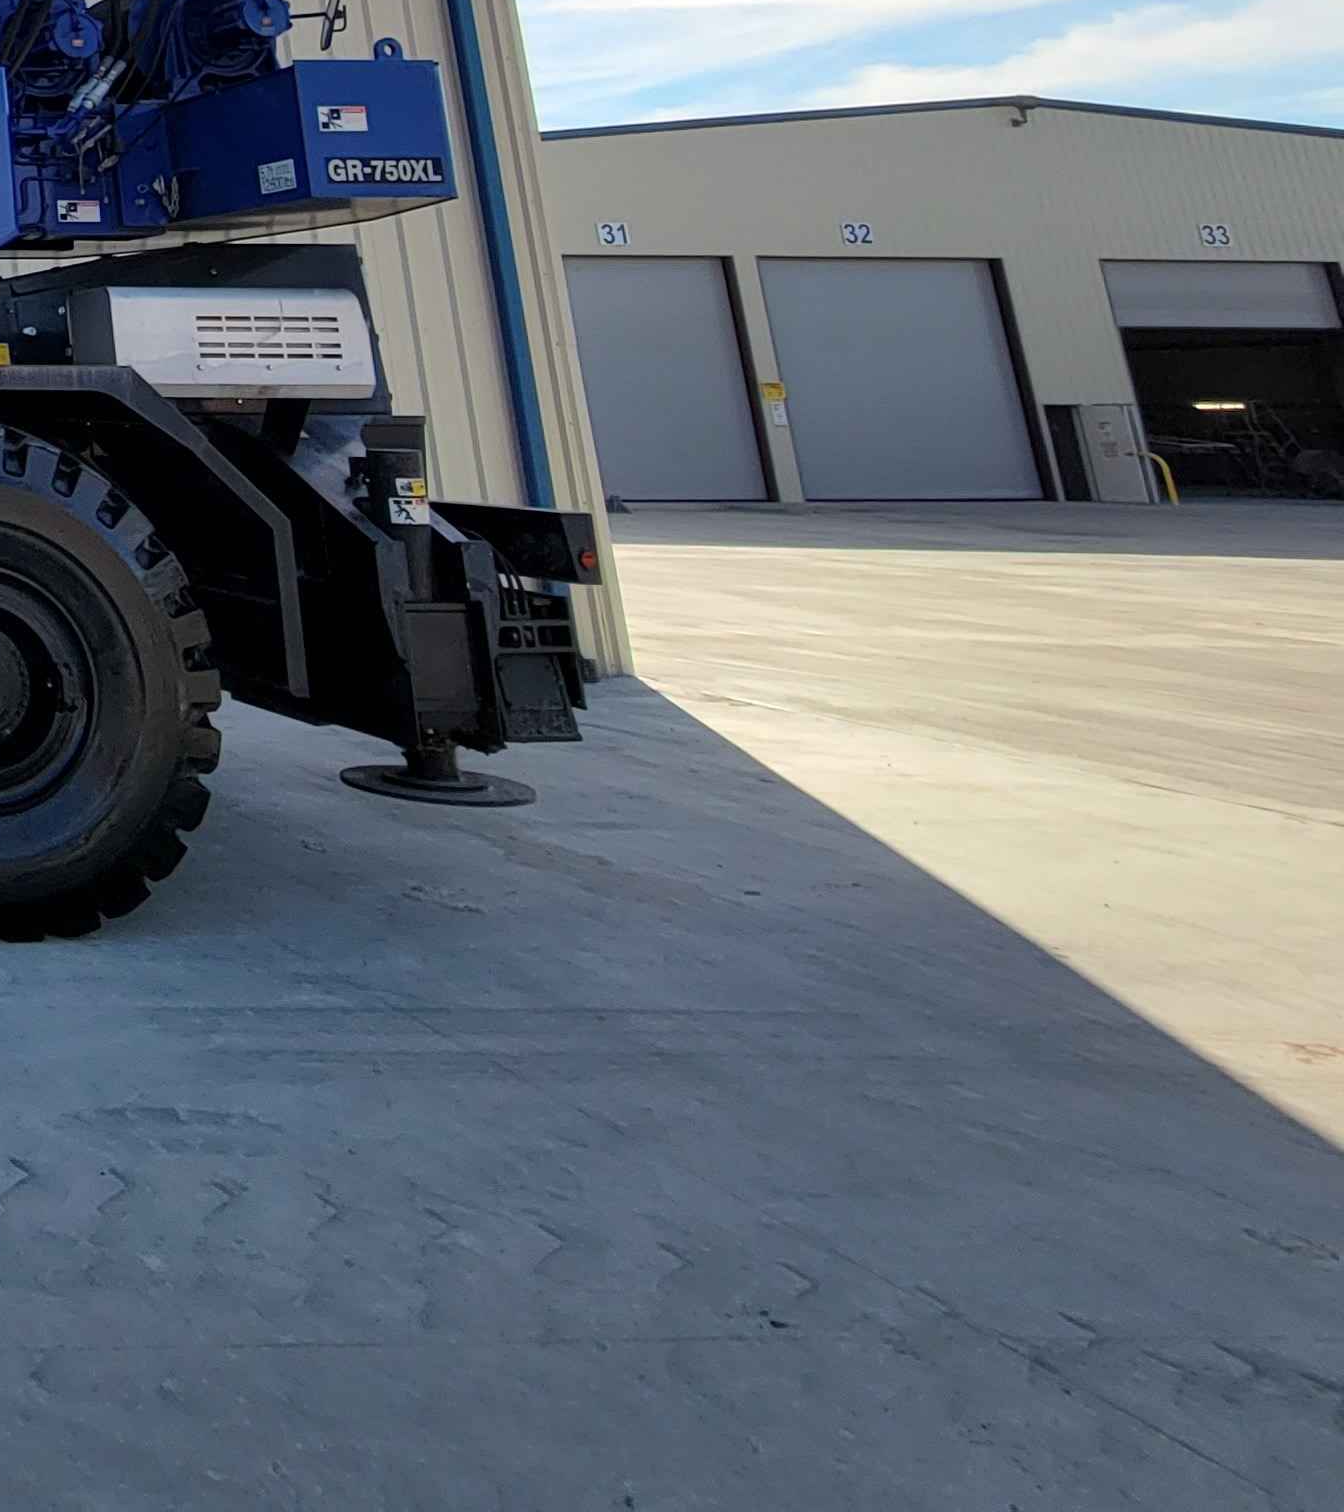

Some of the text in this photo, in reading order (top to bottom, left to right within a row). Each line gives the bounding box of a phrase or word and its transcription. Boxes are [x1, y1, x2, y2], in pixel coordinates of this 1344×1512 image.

[327, 158, 443, 183] GR-750XL
[601, 223, 628, 245] 31
[843, 223, 873, 244] 32
[1201, 225, 1231, 245] 33
